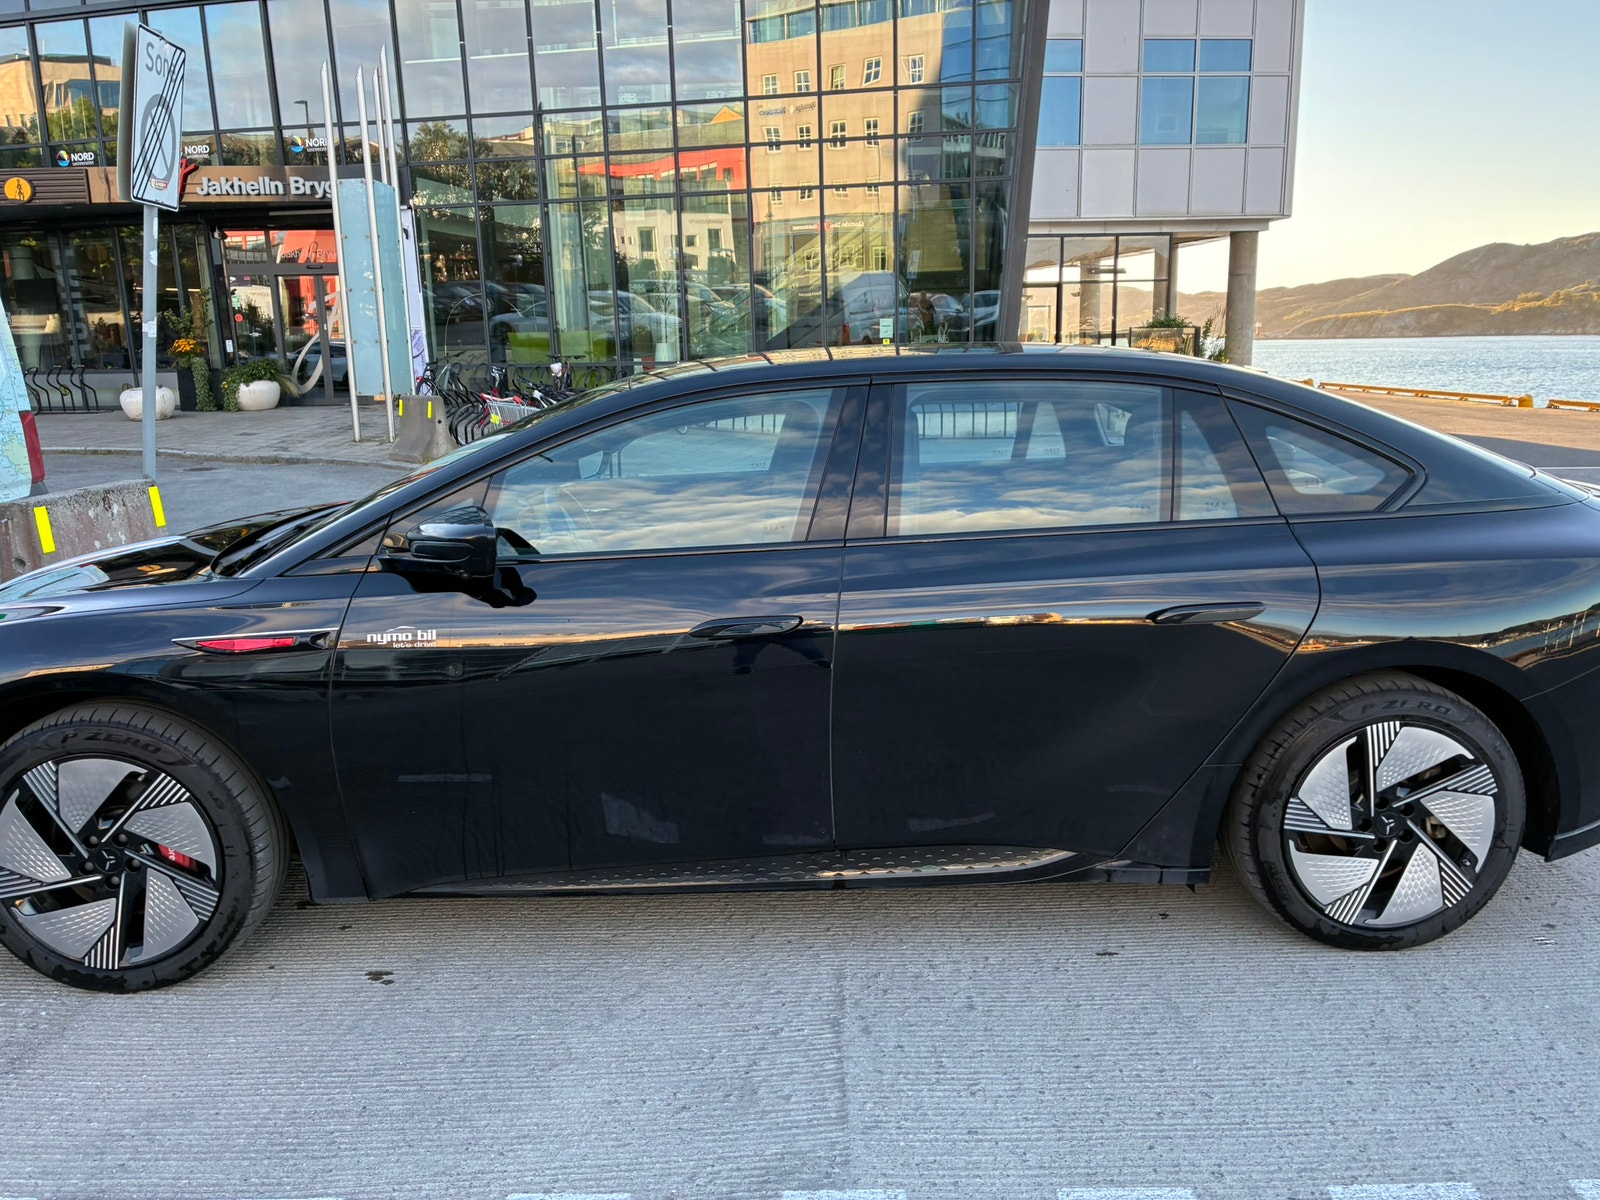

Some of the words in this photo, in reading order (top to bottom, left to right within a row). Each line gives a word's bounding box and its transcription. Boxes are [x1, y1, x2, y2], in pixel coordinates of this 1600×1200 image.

[70, 152, 95, 161] NORD
[184, 145, 210, 154] NORD
[196, 176, 285, 196] Jakhelln
[366, 632, 412, 645] nymo
[417, 629, 437, 641] bil
[1381, 699, 1453, 716] ZERO
[60, 731, 79, 745] P
[83, 731, 162, 755] ZERO
